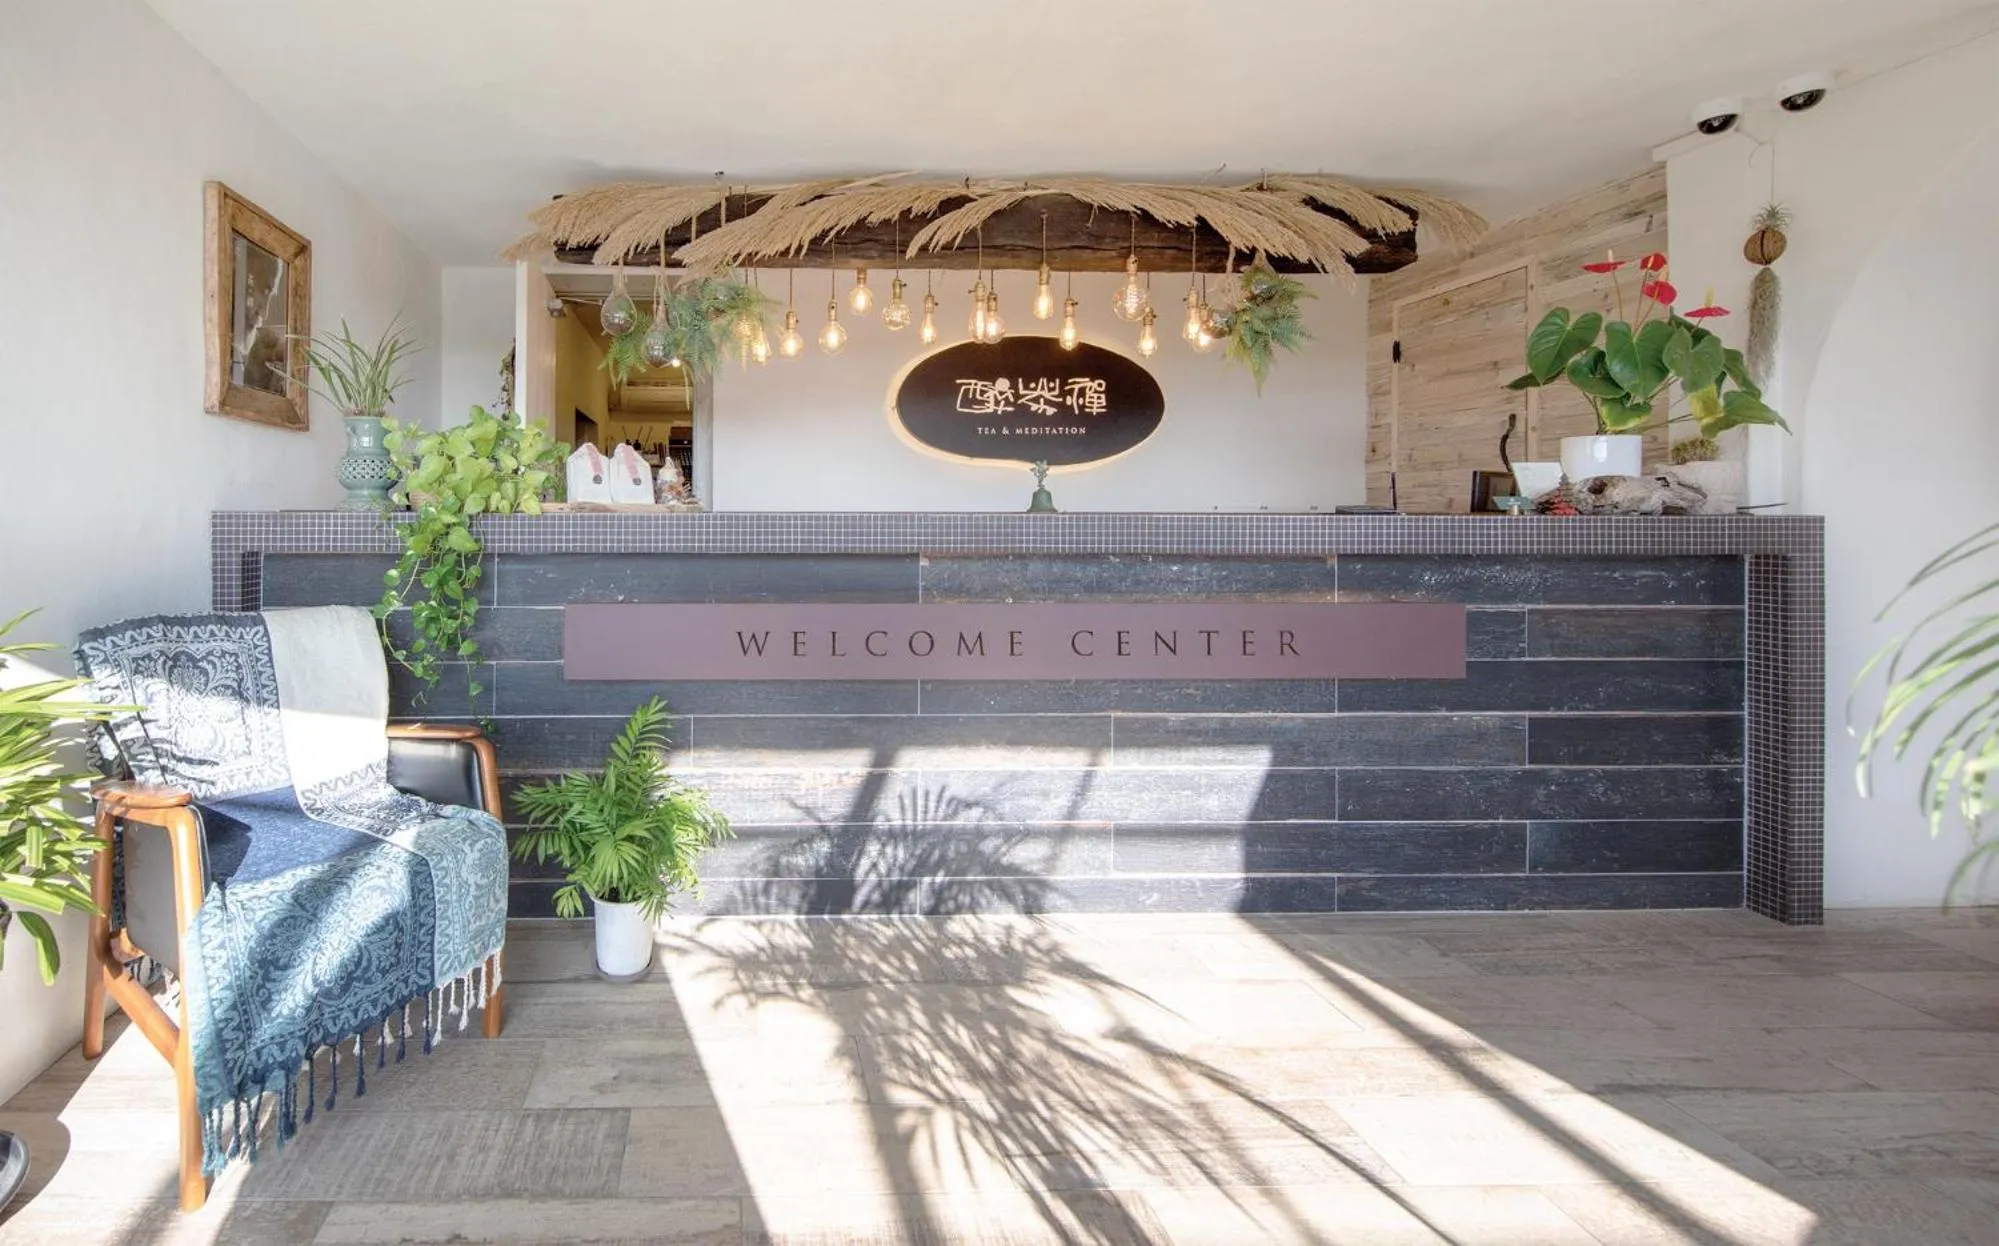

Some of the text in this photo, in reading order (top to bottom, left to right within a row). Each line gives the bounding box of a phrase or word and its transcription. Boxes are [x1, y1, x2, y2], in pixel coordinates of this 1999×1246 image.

[977, 426, 1087, 435] TEA & MEDITATION
[736, 630, 1300, 657] WELCOME CENTER
